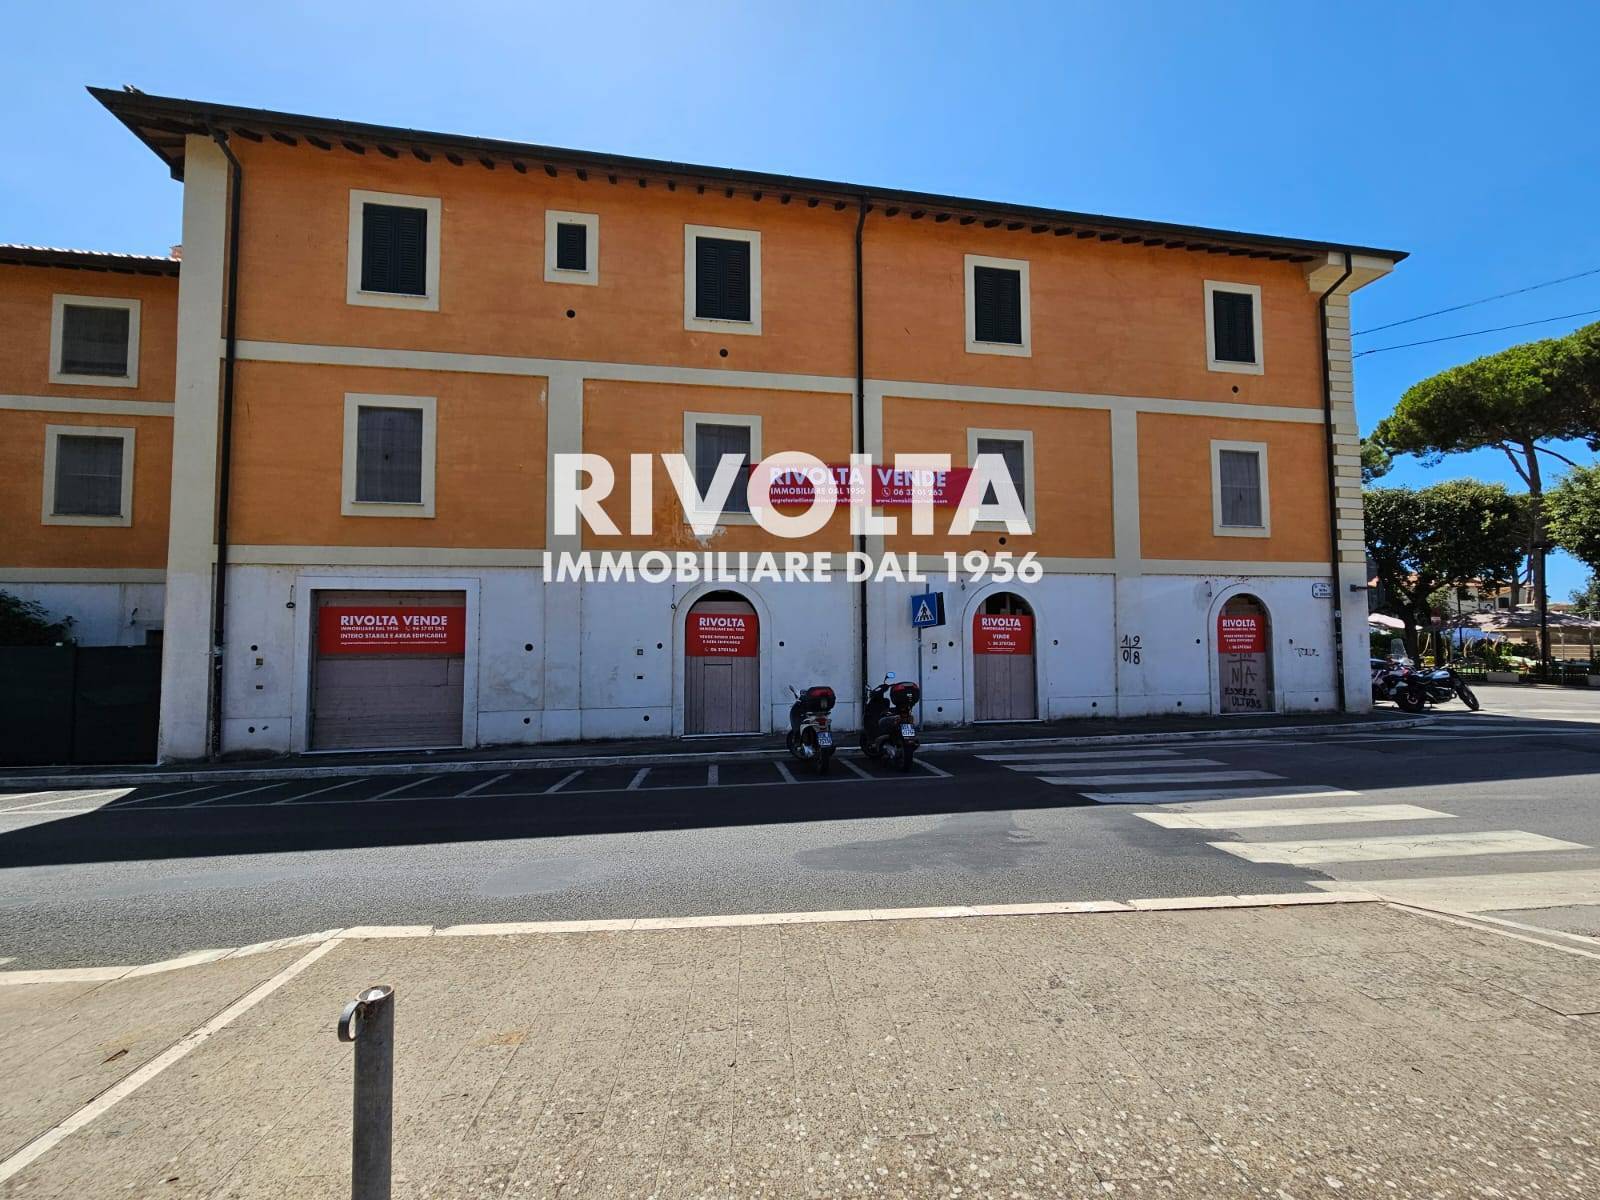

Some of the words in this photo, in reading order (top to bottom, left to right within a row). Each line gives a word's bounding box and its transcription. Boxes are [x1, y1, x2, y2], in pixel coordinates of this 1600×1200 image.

[769, 466, 864, 485] RIVOLTA
[877, 468, 947, 487] VENDE
[340, 615, 398, 626] RIVOLTA
[402, 615, 448, 626] VENDE
[699, 617, 745, 627] RIVOLTA
[981, 618, 1021, 627] RIVOLTA
[1222, 619, 1256, 627] RIVOLTA
